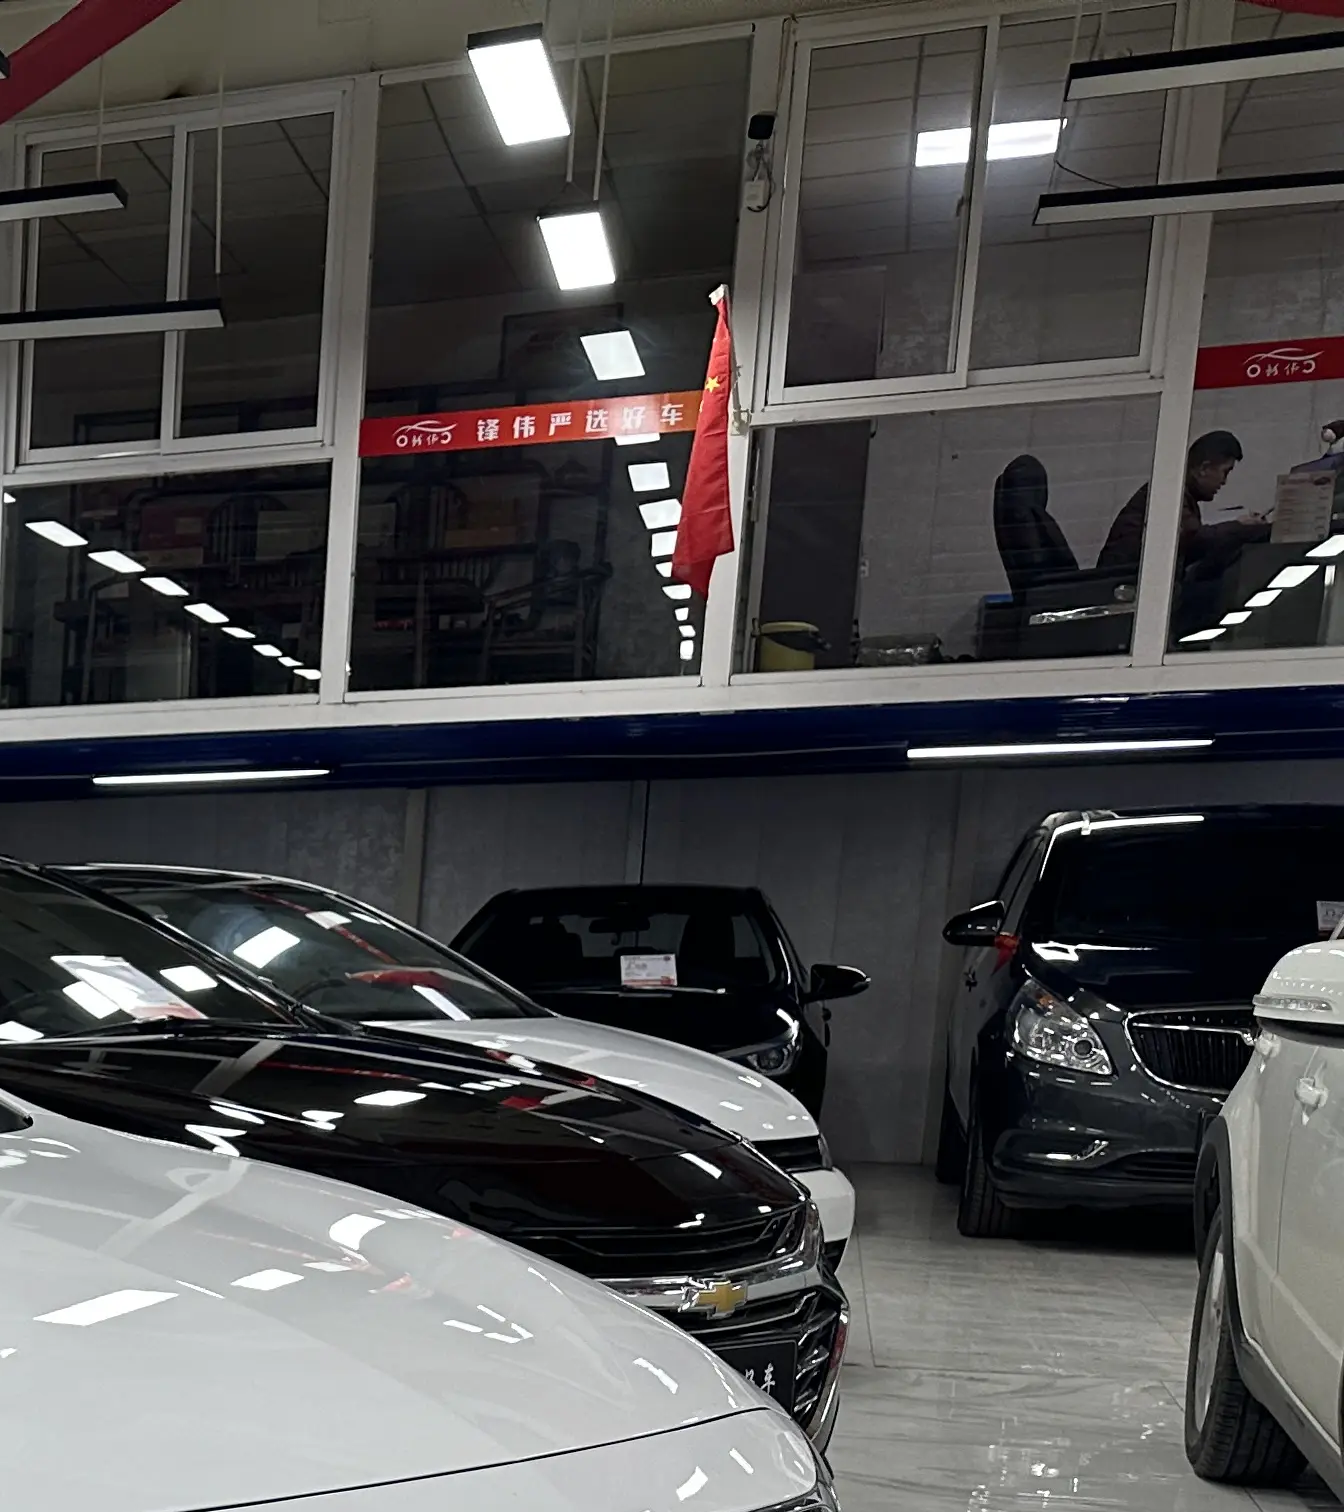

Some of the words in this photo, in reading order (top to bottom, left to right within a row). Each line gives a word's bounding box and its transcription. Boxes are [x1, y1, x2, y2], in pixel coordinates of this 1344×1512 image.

[476, 403, 684, 442] 锋伟严选好车
